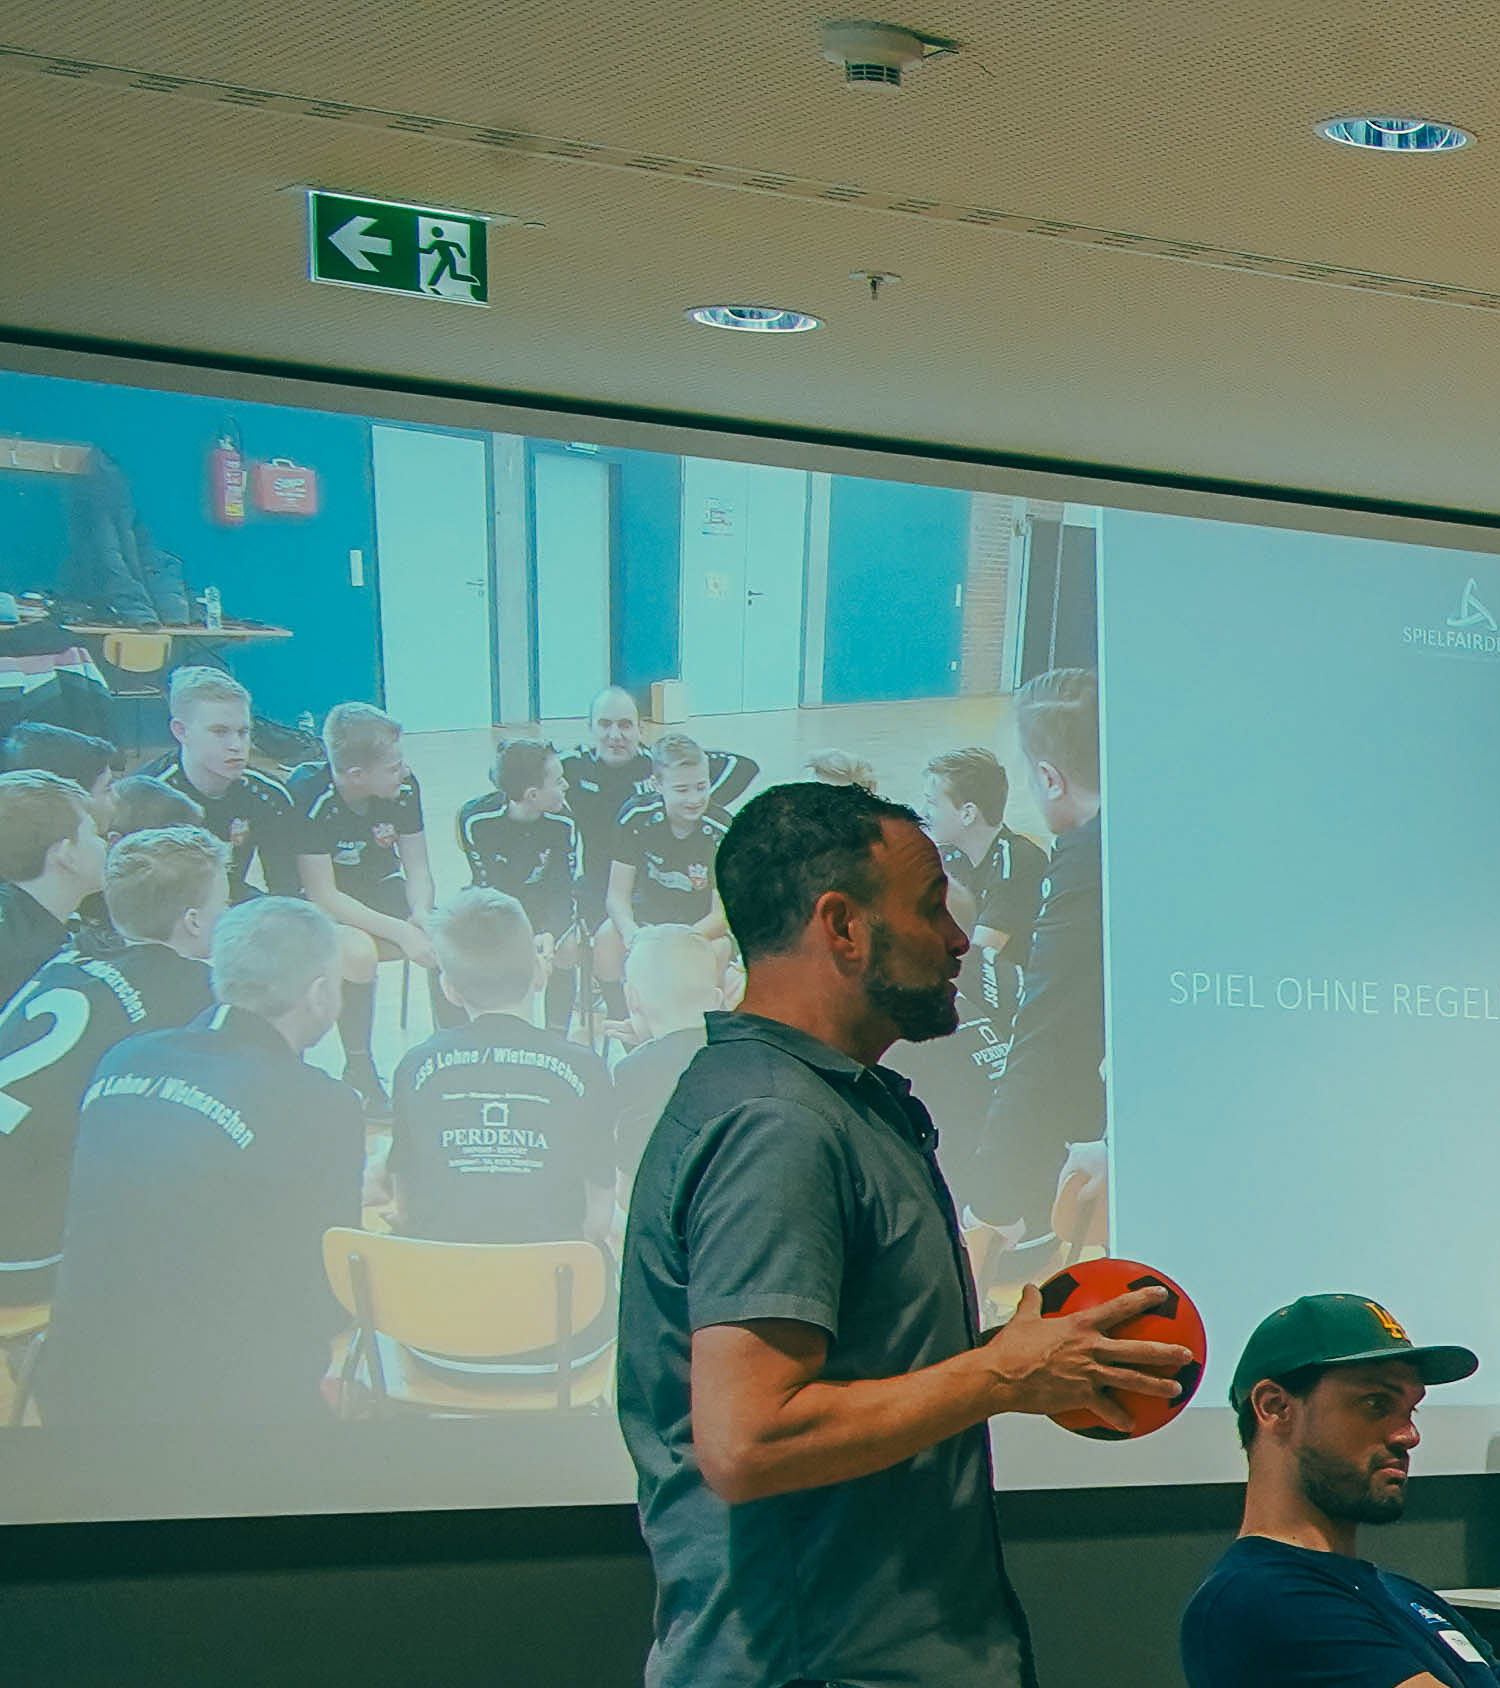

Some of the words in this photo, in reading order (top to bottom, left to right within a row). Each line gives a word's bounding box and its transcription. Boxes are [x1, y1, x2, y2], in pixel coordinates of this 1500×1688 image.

[1169, 971, 1265, 1008] SPIEL
[1276, 976, 1378, 1015] OHNE
[436, 1049, 480, 1070] Lohne
[493, 1047, 586, 1097] Wietmarschen
[441, 1129, 549, 1149] PERDENIA
